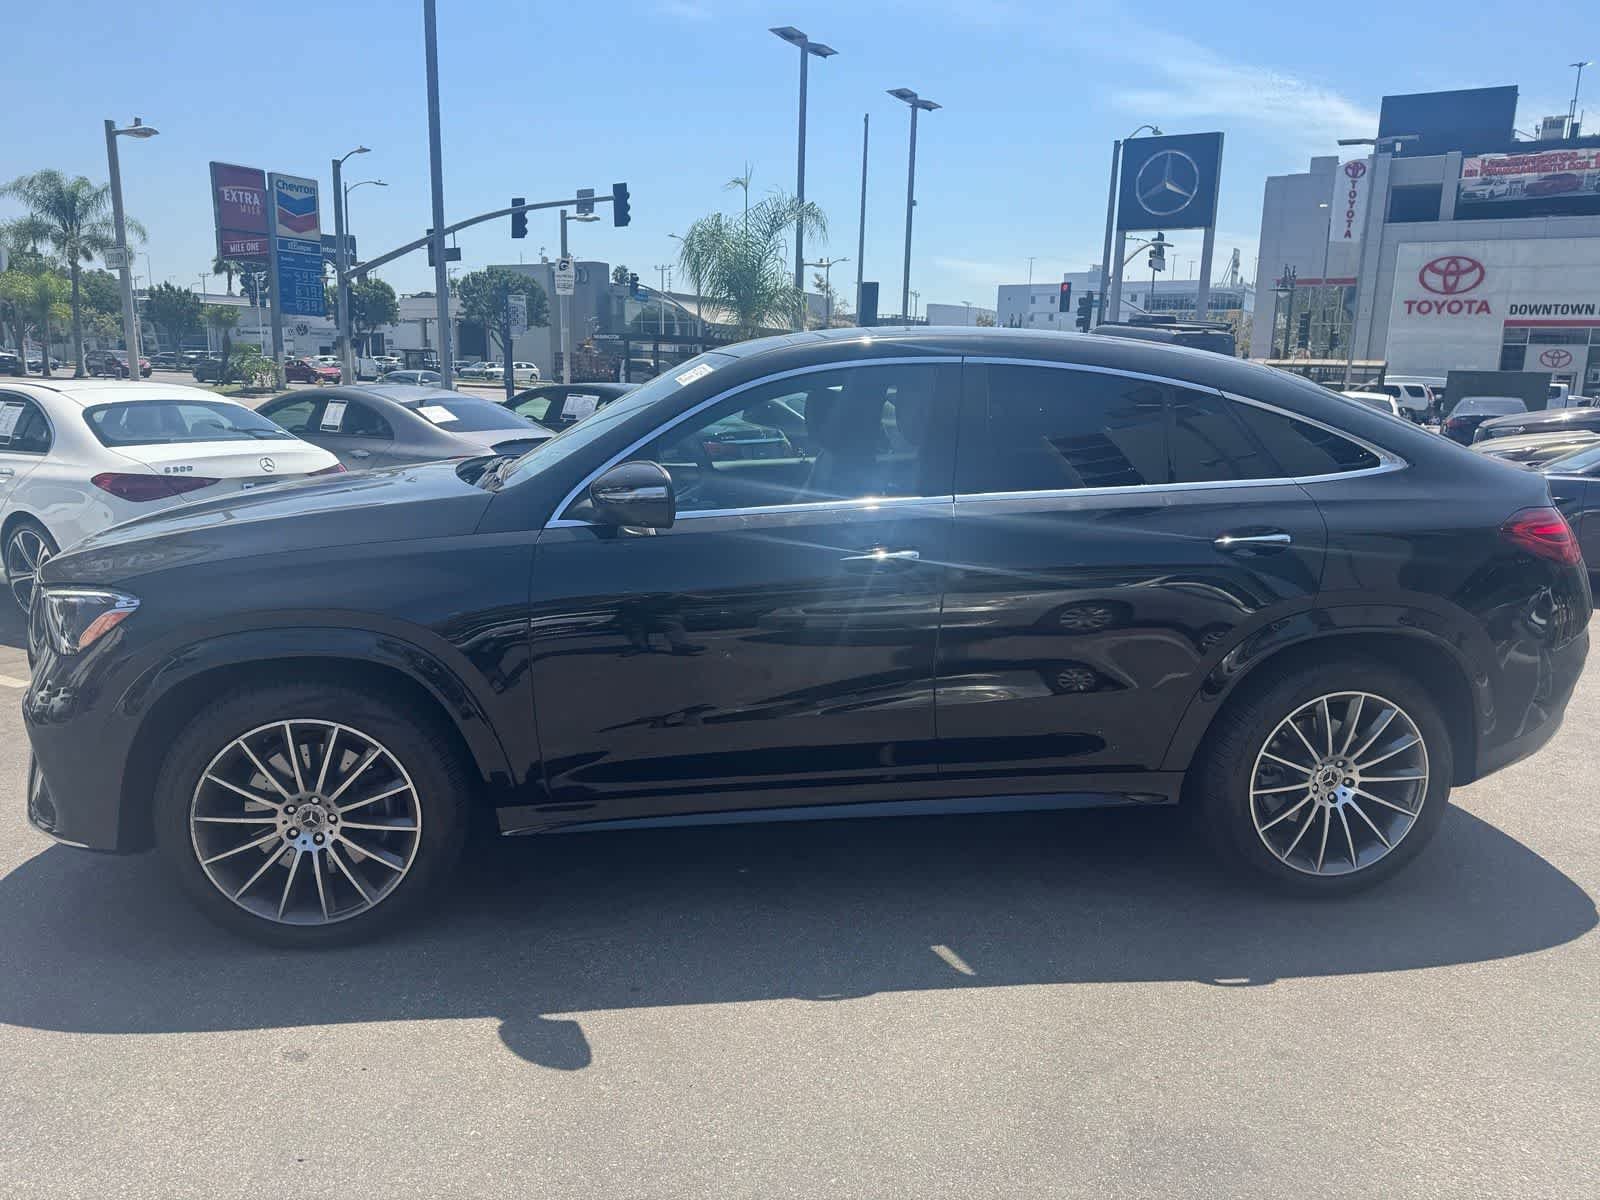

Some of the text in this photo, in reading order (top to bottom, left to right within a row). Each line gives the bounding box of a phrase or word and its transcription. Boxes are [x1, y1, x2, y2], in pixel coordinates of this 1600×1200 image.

[275, 179, 316, 195] Chevron
[223, 189, 261, 206] EXTRA
[1344, 180, 1358, 239] TOYOTA
[229, 241, 260, 253] MILE ONE
[1404, 300, 1491, 315] TOYOTA
[1509, 303, 1595, 315] DOWNTOWN
